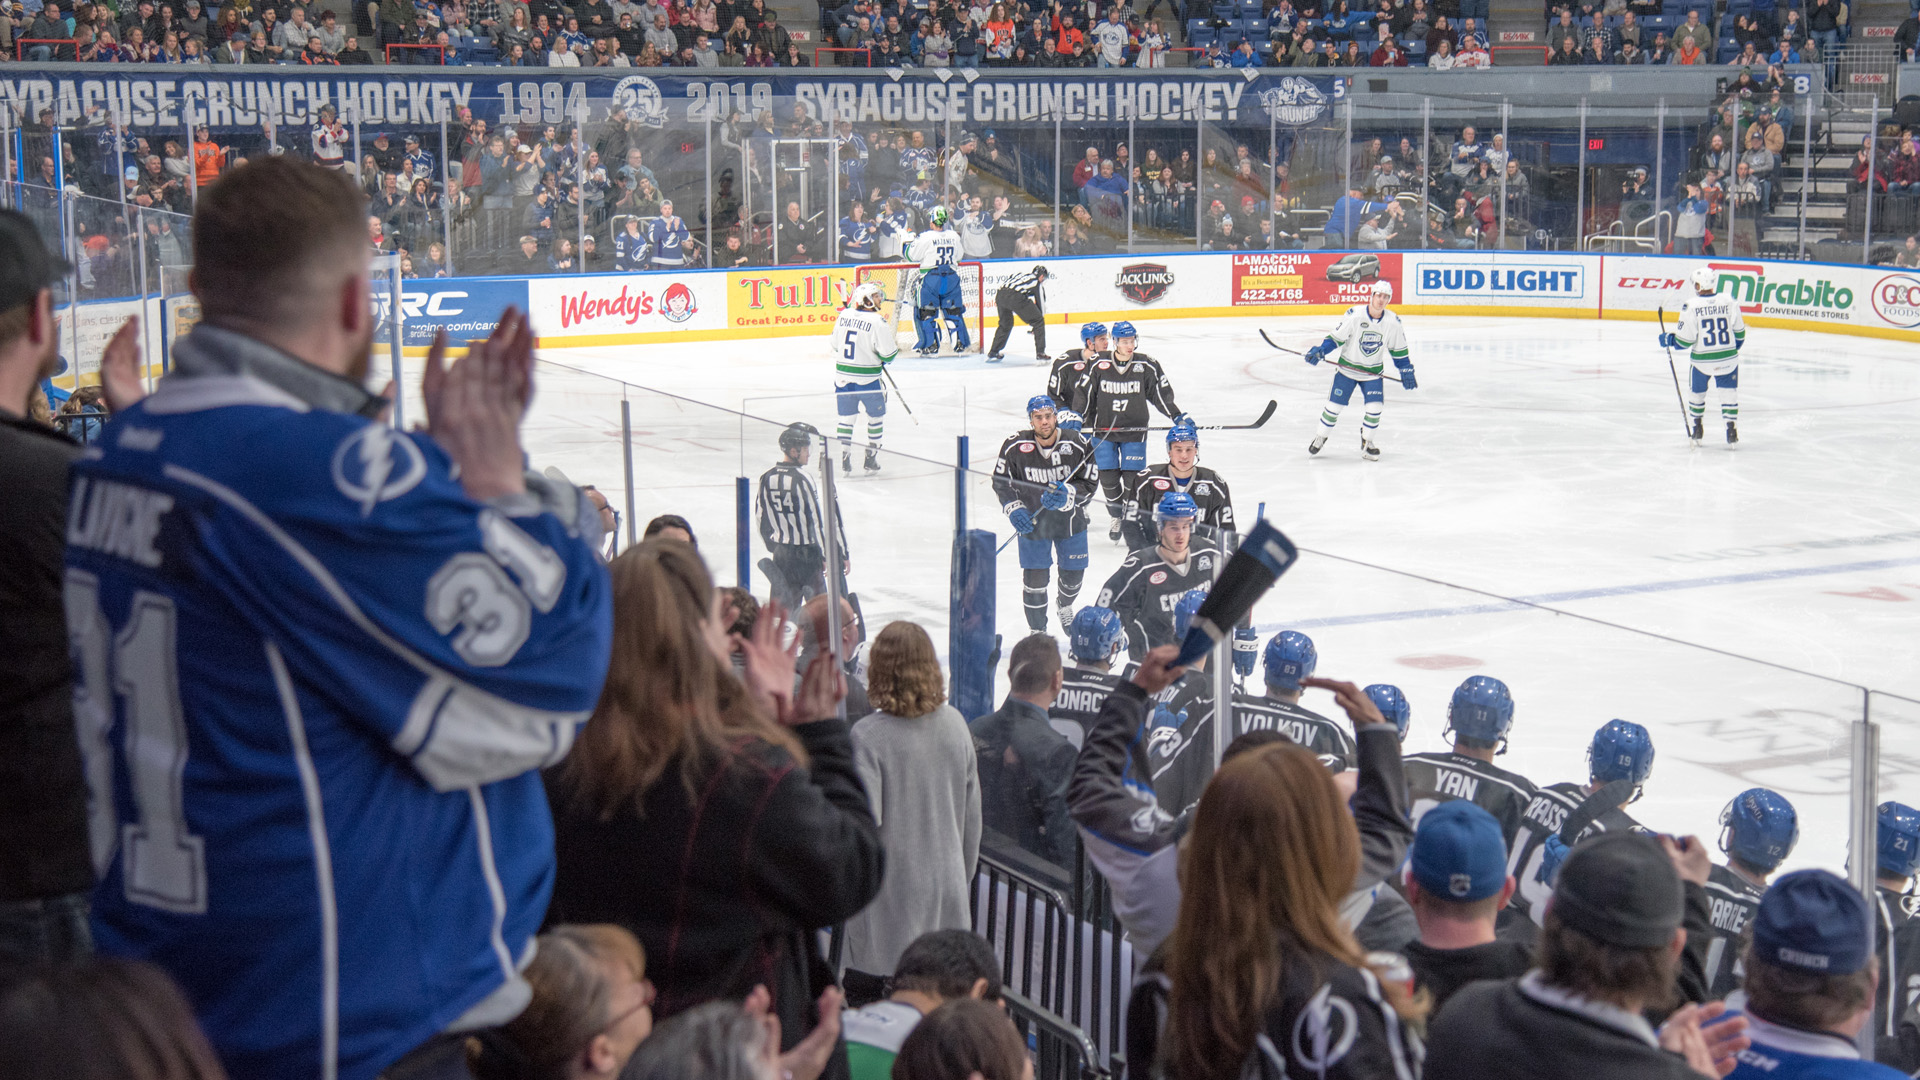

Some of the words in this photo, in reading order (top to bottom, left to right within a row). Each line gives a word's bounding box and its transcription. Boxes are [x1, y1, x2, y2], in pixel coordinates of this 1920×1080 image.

[0, 80, 178, 126] YRACUSE
[183, 80, 329, 126] CRUNCH
[337, 81, 473, 125] HOCKEY
[497, 82, 590, 123] 1994
[686, 82, 773, 123] 2019
[795, 82, 967, 122] SYRACUSE
[973, 82, 1107, 122] CRUNCH
[1115, 82, 1245, 121] HOCKEY
[1588, 139, 1604, 150] EXIT
[935, 246, 954, 266] 33
[1234, 254, 1311, 265] LAMACCHIA
[1250, 265, 1295, 275] HONDA
[1116, 273, 1143, 286] JACK
[1423, 269, 1485, 289] BUD
[1491, 270, 1577, 291] LIGHT
[1618, 277, 1685, 290] CCM
[1240, 289, 1303, 300] 422-4168
[561, 284, 654, 328] Wendy's
[1695, 305, 1729, 317] PETGRAVE
[1764, 307, 1819, 318] CONVENIENCE
[1821, 311, 1849, 320] STORES
[1883, 307, 1920, 318] FOODS
[736, 317, 770, 326] Great
[775, 315, 803, 324] Food
[808, 314, 816, 322] &
[839, 317, 872, 333] CHATFIELD
[1701, 317, 1730, 347] 38
[844, 330, 858, 360] 5
[1101, 379, 1141, 395] CRUNCH
[1112, 399, 1129, 413] 27
[1051, 451, 1062, 467] A
[1024, 466, 1072, 485] CRUNCH
[1084, 462, 1100, 481] 15
[769, 490, 795, 512] 54
[1284, 664, 1297, 676] 83
[1476, 709, 1488, 722] 11
[1618, 754, 1632, 767] 19
[1434, 768, 1479, 801] YAN
[1893, 837, 1910, 852] 21
